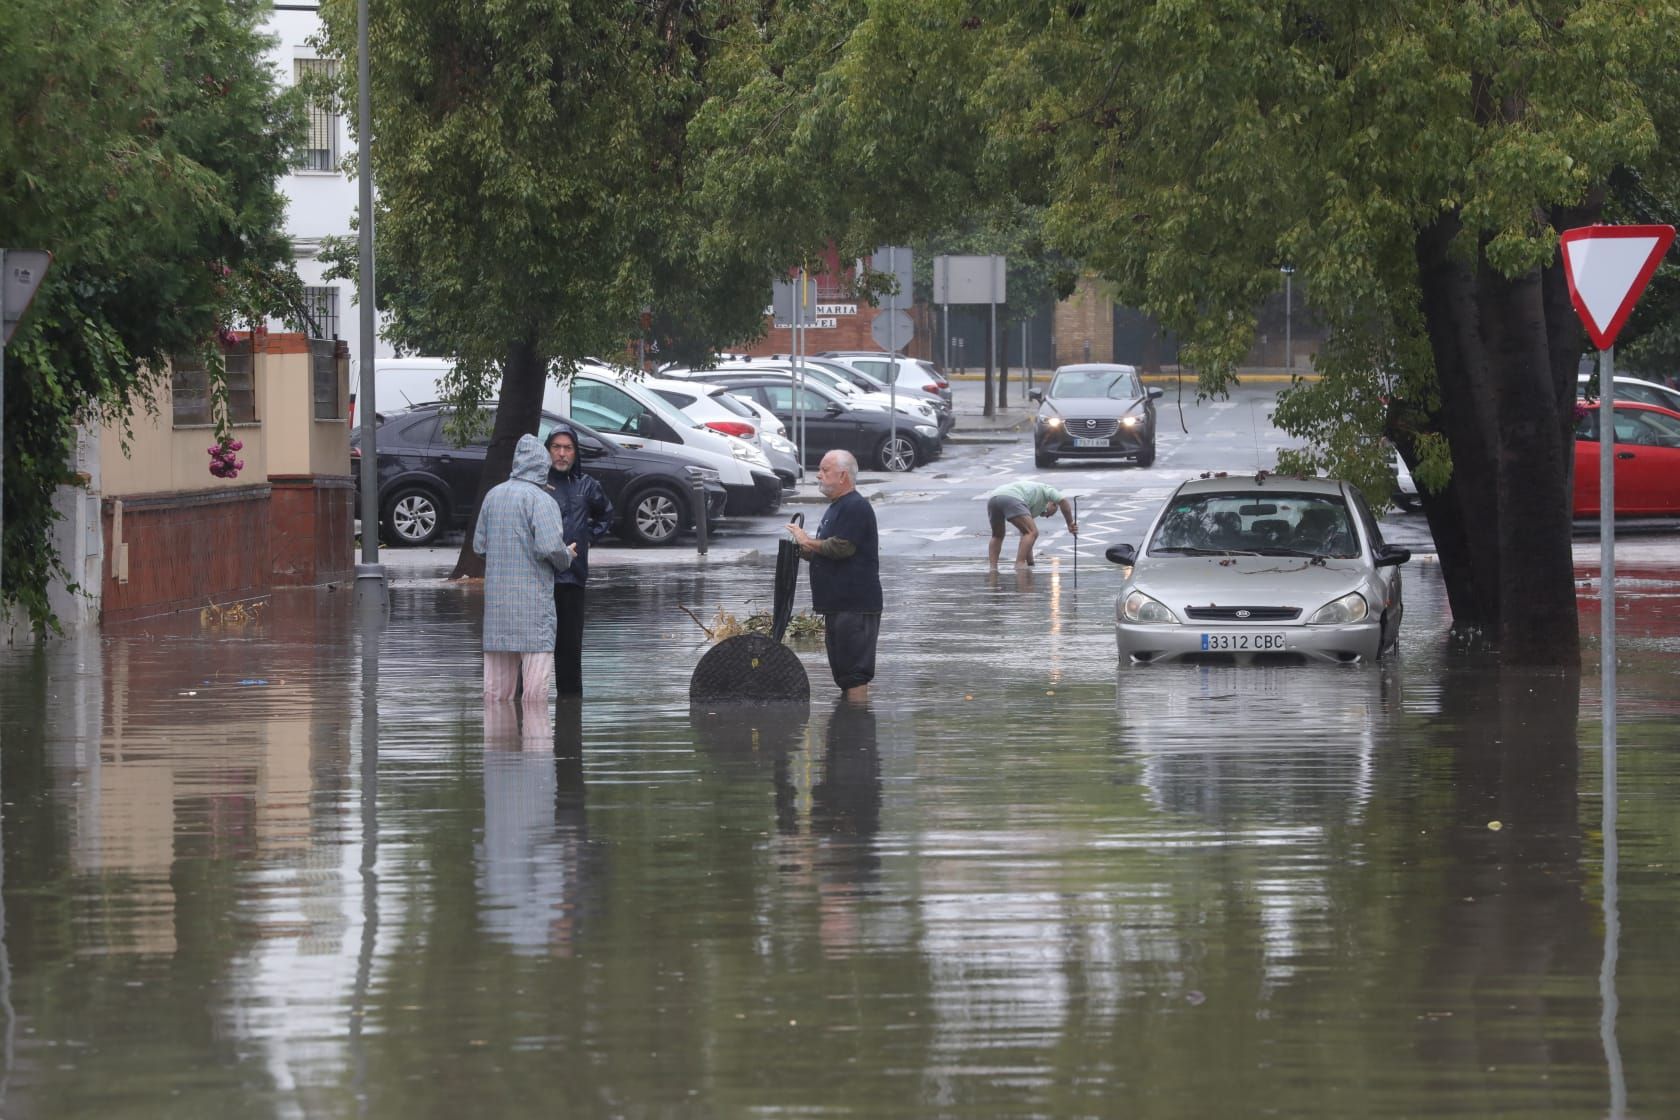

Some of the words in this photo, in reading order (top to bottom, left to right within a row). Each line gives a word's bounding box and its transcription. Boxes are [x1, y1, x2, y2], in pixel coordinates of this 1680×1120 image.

[817, 306, 856, 314] MARIA
[1210, 635, 1248, 649] 3312
[1254, 635, 1283, 649] CBC
